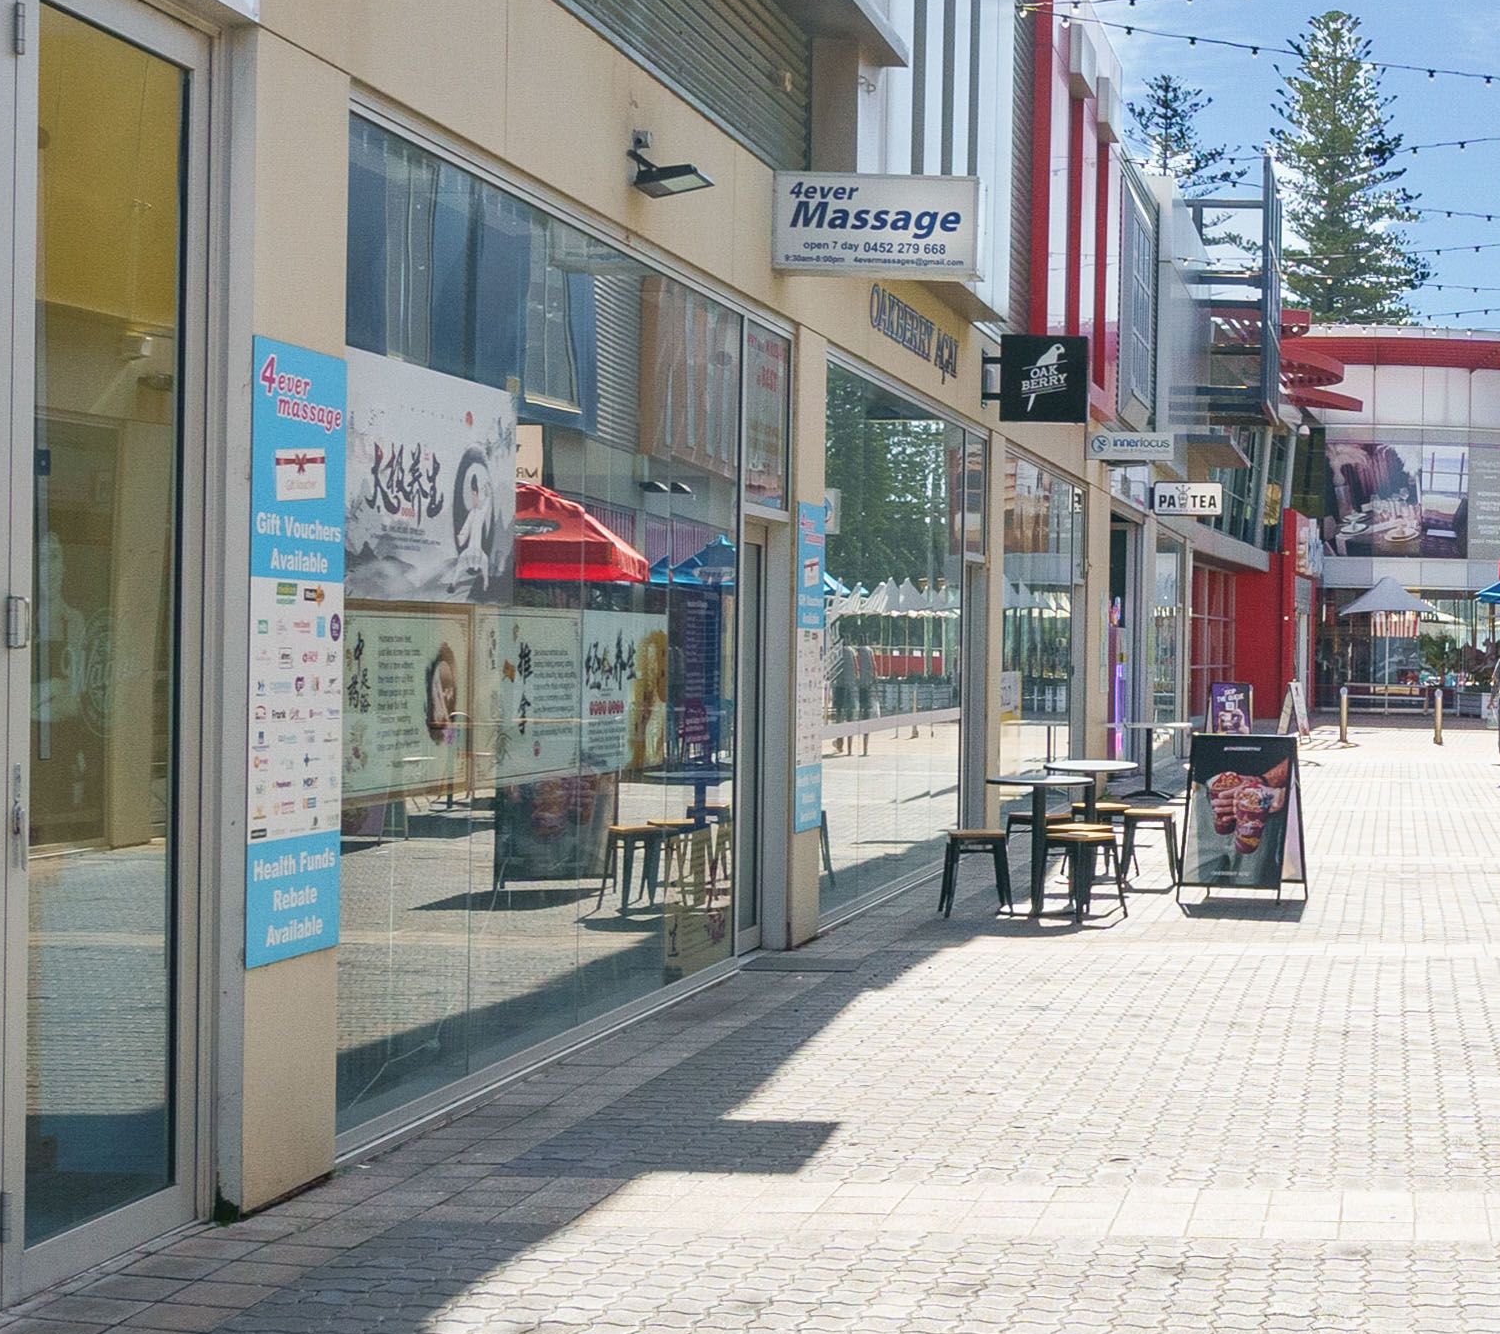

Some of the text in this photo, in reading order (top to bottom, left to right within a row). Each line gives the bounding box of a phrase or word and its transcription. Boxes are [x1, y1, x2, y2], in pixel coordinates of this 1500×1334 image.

[789, 181, 859, 201] 4ever
[789, 200, 962, 240] Massage
[803, 241, 946, 255] open 7 day 0452 279 668
[852, 255, 965, 267] 4evermassages@gmail.com
[869, 282, 936, 362] OAKBERRY
[260, 353, 312, 398] 4ever
[1021, 373, 1068, 391] BERRY
[1030, 364, 1059, 379] OAK
[277, 395, 342, 434] massage
[1112, 437, 1170, 448] innerfocus
[1158, 494, 1217, 508] PA TEA
[256, 511, 281, 536] Gift
[283, 515, 342, 544] Vouchers
[270, 547, 328, 575] Available
[253, 847, 336, 882] Health Funds
[272, 885, 318, 912] Rebate
[265, 916, 324, 948] Available
